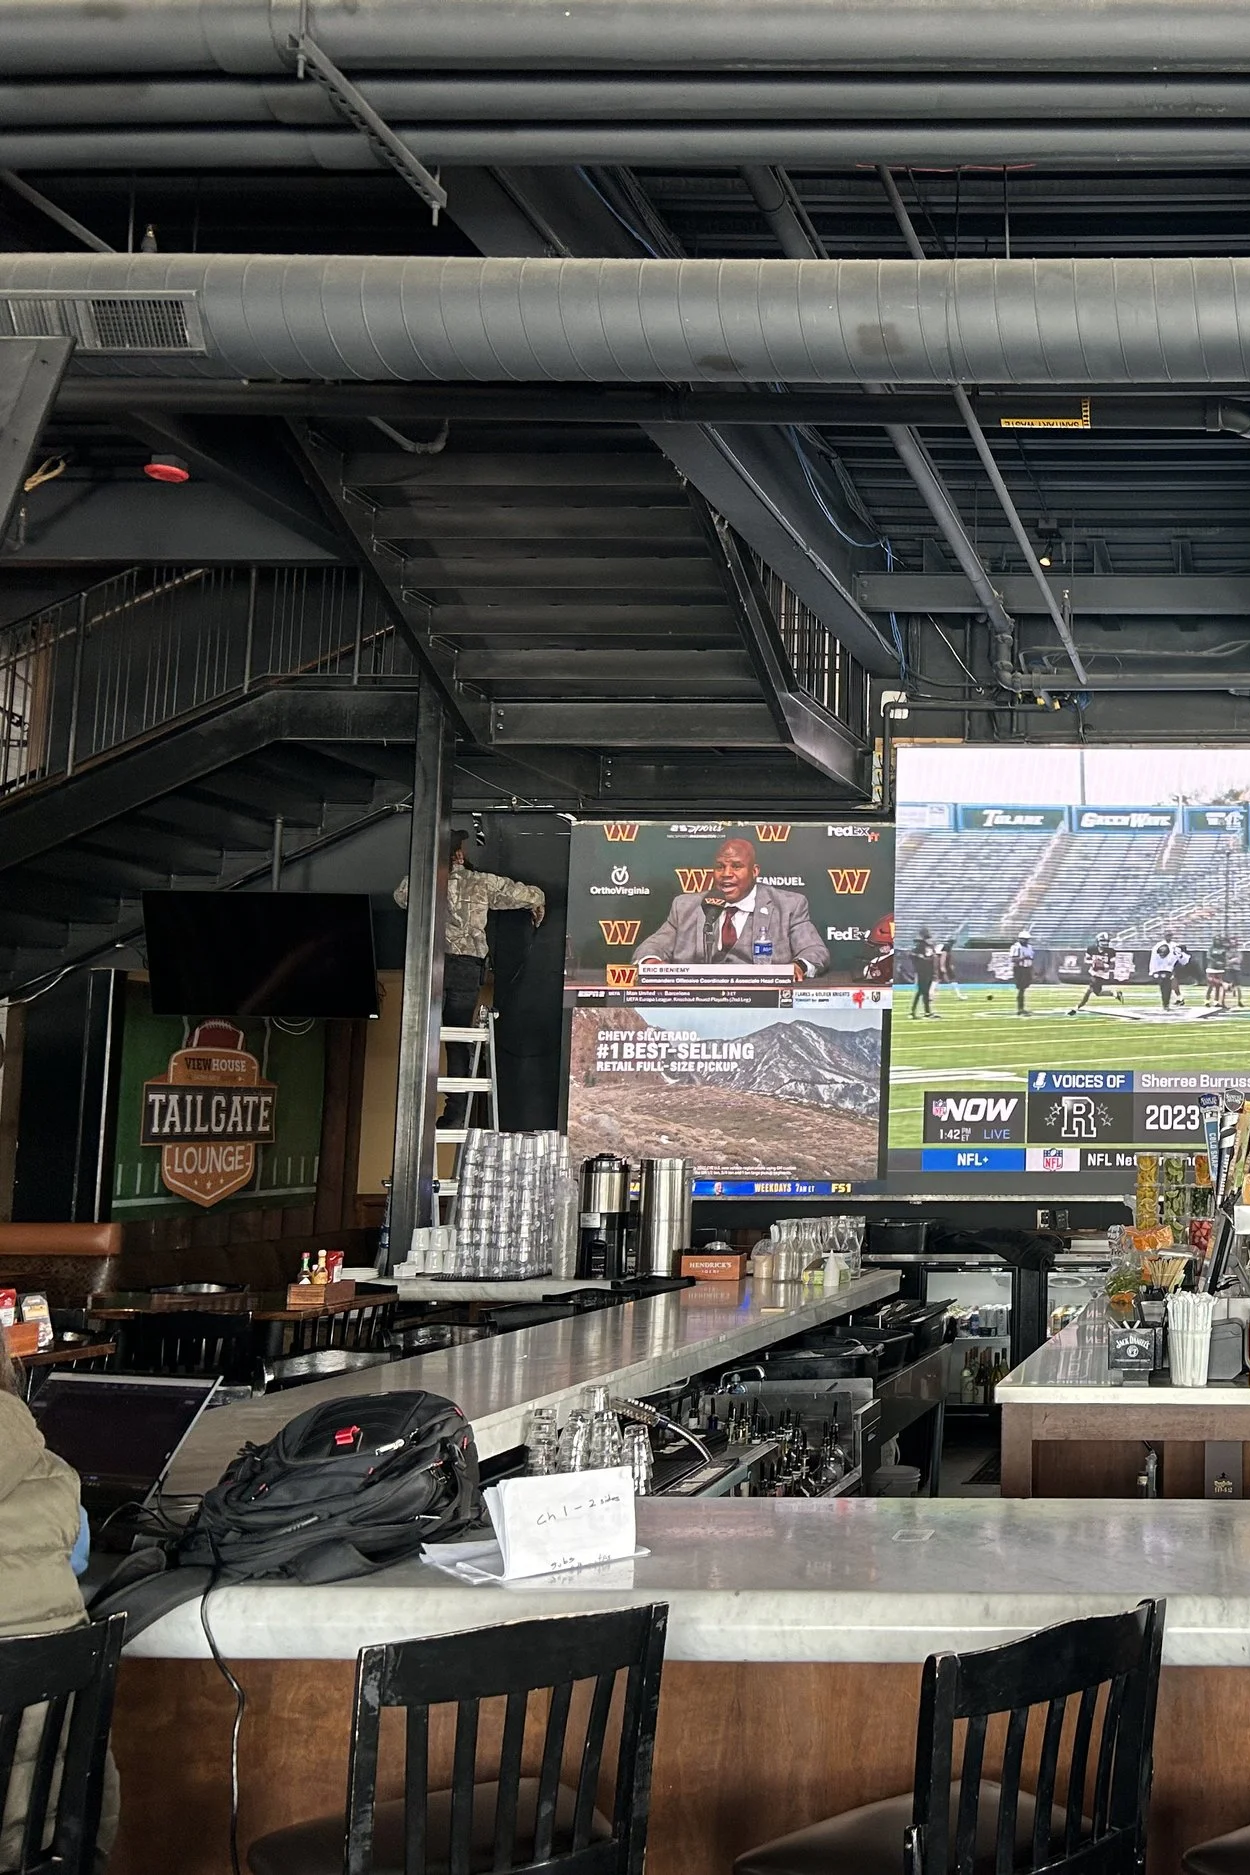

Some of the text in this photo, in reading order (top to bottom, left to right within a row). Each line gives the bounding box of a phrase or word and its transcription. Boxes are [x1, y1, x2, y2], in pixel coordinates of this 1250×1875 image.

[590, 886, 650, 896] OrthoVirginia
[597, 1030, 700, 1042] CHEVY SILVERADO.
[597, 1043, 755, 1060] #1 BEST-SELLING
[185, 1057, 247, 1072] VIEWHOUSE
[597, 1061, 741, 1073] RETAIL FULL-SIZE PICKUP.
[1053, 1074, 1125, 1088] VOICES OF
[1142, 1074, 1197, 1088] Sherree
[148, 1094, 273, 1134] TAILGATE
[941, 1098, 1018, 1121] NOW
[1145, 1105, 1200, 1130] 2023
[939, 1129, 960, 1140] 1:42
[961, 1134, 970, 1142] ET
[983, 1129, 1011, 1140] LIVE
[1208, 1132, 1218, 1149] COLD
[174, 1145, 246, 1174] LOUNGE
[1087, 1153, 1112, 1166] NFL
[754, 1183, 791, 1193] WEEKDAYS
[831, 1183, 852, 1193] FS1
[689, 1261, 733, 1269] HENDRICK'S
[1116, 1337, 1130, 1349] JACK
[588, 1498, 597, 1508] 2
